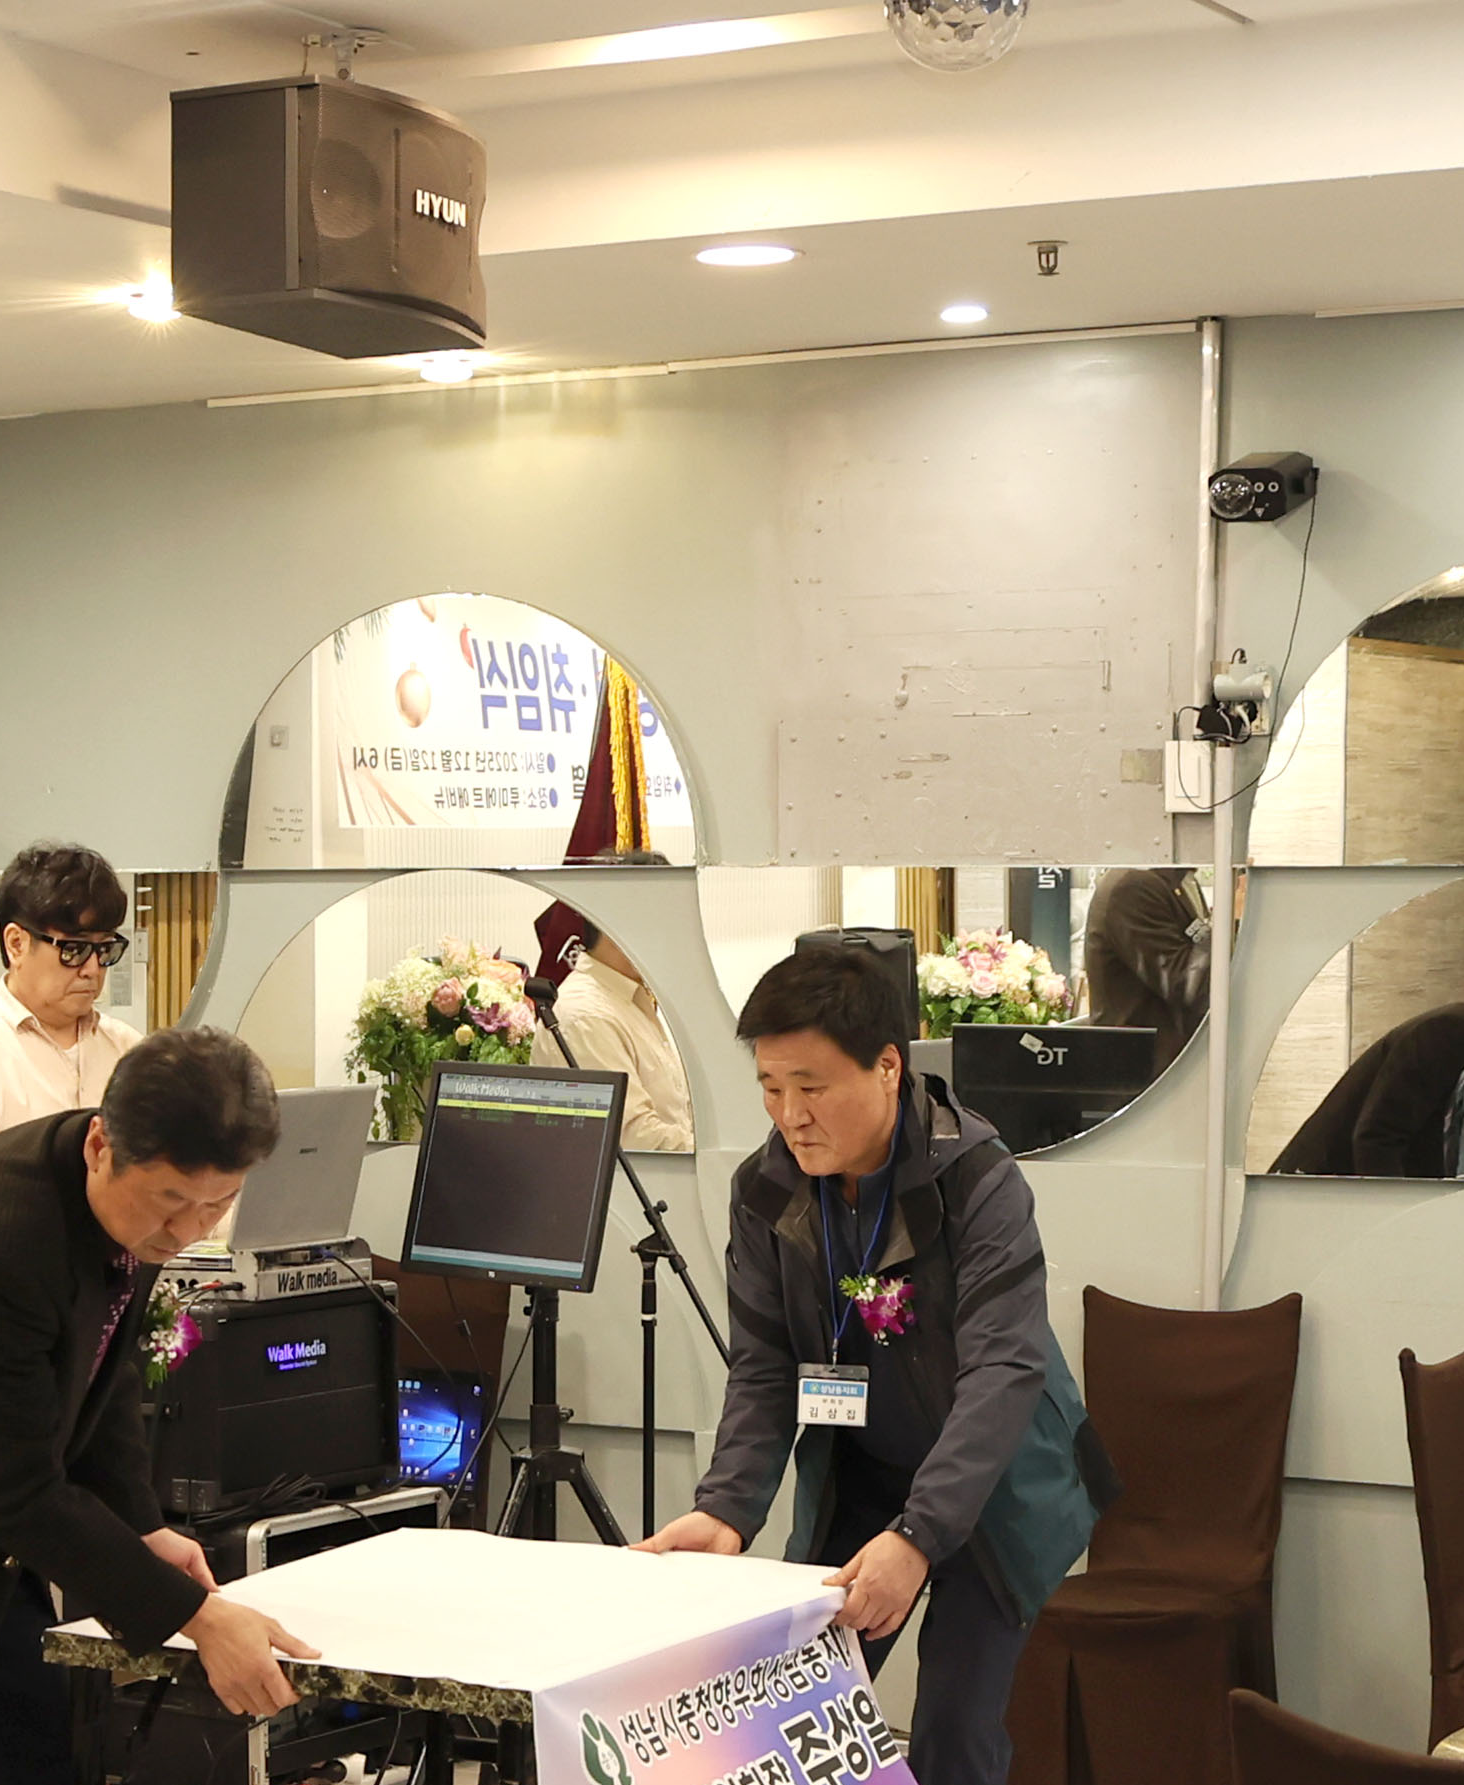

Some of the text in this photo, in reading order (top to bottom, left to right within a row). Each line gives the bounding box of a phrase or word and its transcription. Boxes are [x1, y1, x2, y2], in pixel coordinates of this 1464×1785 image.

[415, 189, 466, 227] HYUN
[277, 1267, 338, 1294] Walk media
[266, 1339, 327, 1363] Walk Media
[619, 1624, 851, 1765] 성남시충청향우회성남동지
